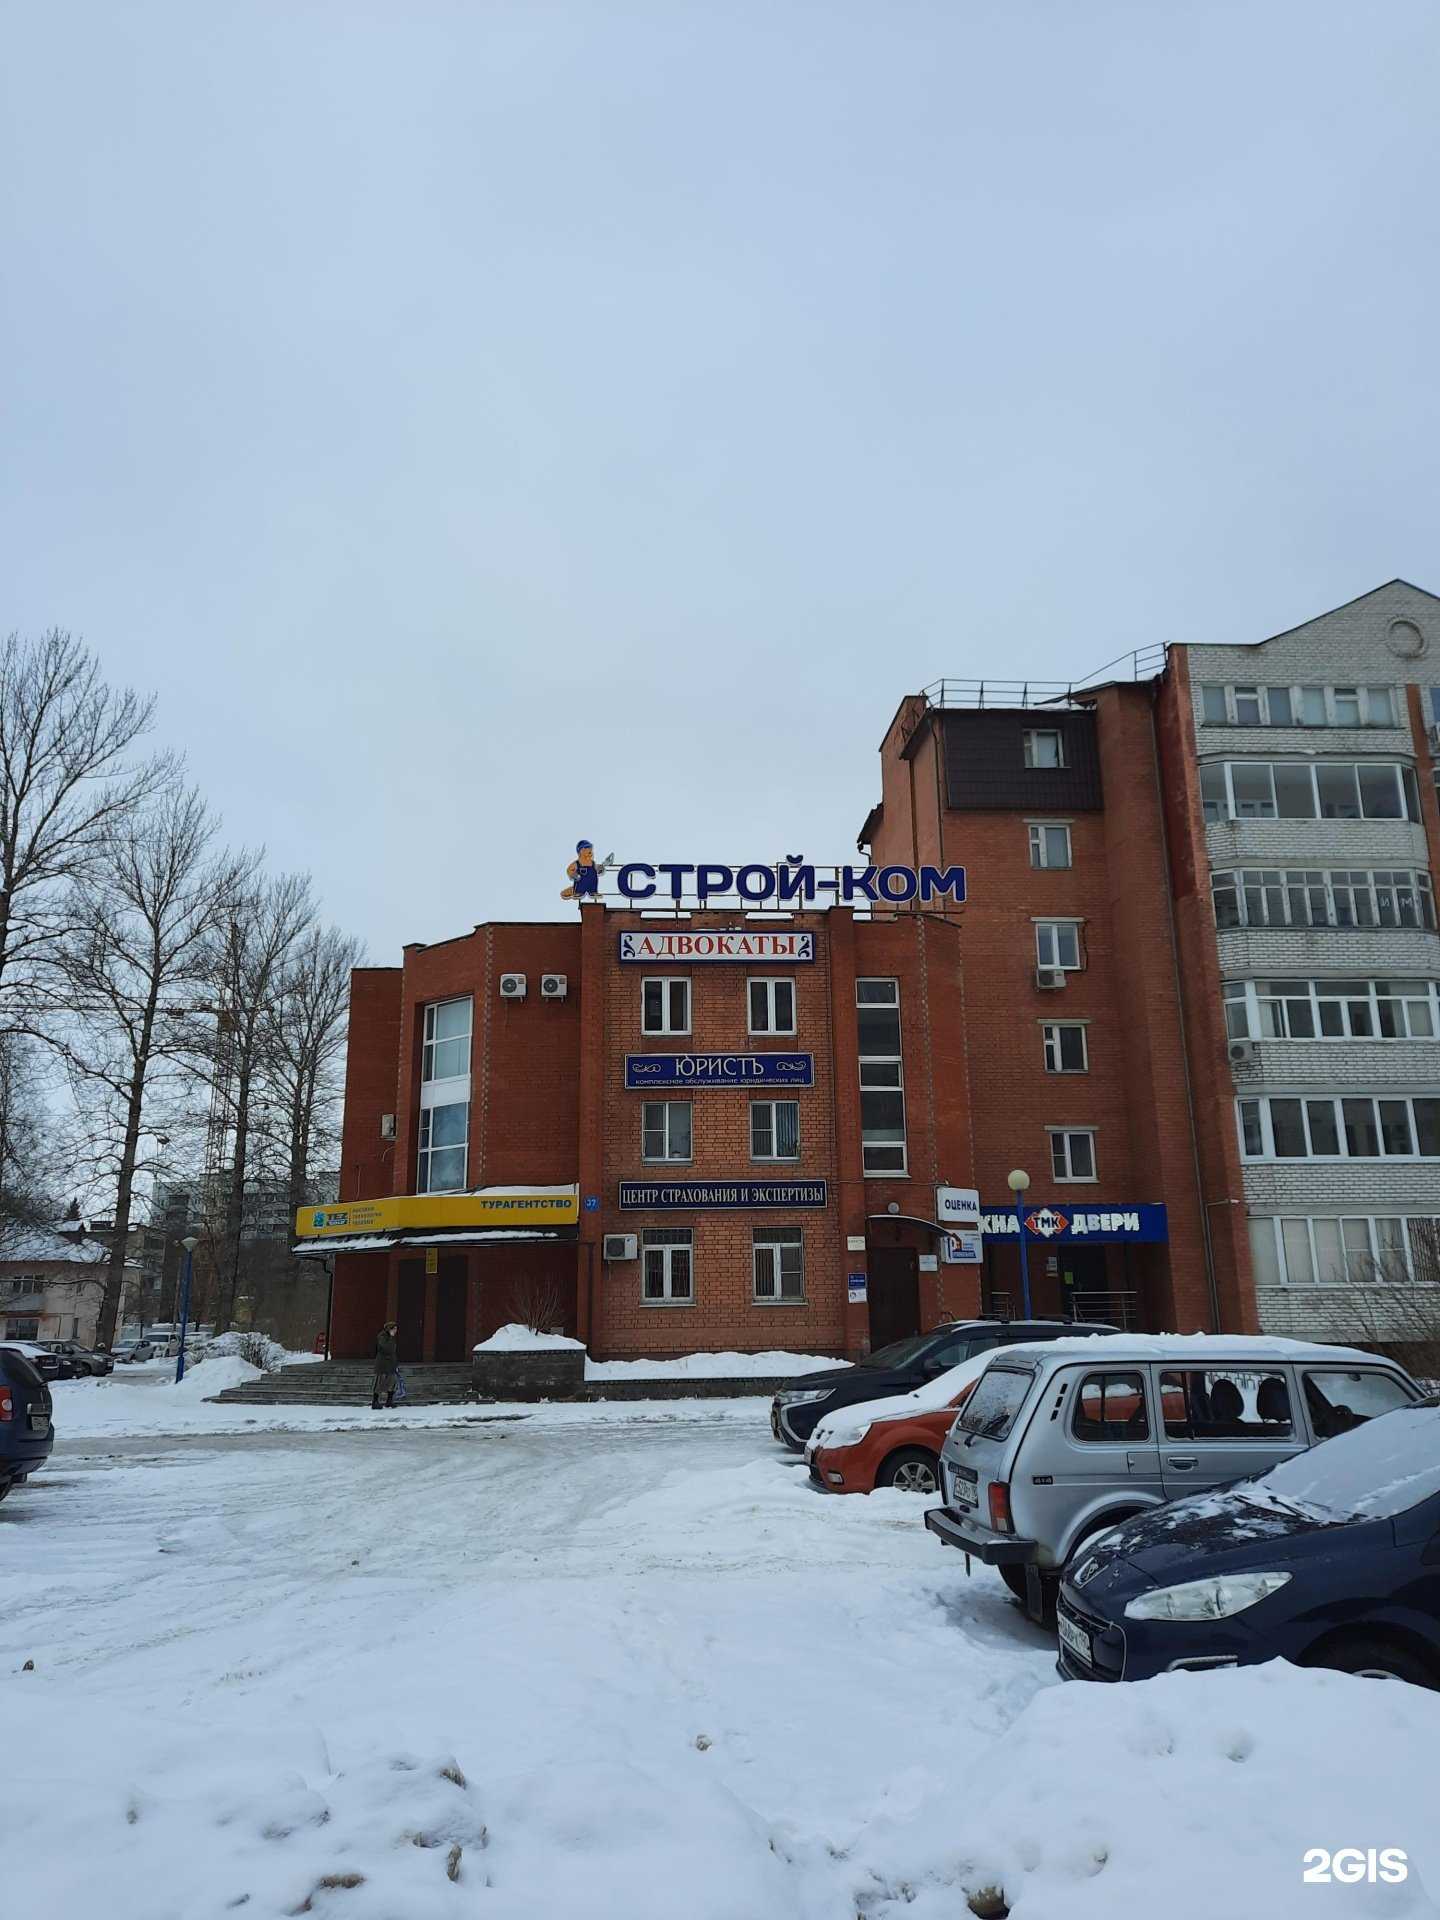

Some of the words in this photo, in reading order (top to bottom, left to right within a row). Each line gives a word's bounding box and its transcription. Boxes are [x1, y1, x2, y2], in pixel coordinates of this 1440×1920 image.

[617, 854, 967, 903] СТРОЙ-КОМ
[638, 935, 797, 958] АДВОКАТЫ
[675, 1055, 764, 1076] ЮРИСТЪ
[480, 1199, 572, 1210] ТУРАГЕНТСТВО
[622, 1189, 658, 1204] ЦЕНТР
[661, 1188, 737, 1203] СТРАХОВАНИЯ
[740, 1188, 749, 1202] И
[752, 1187, 824, 1202] ЭКСПЕРТИЗЫ
[944, 1199, 978, 1211] ОЦЕНКА
[976, 1214, 1021, 1234] КНА
[1033, 1216, 1060, 1229] ТМК
[1071, 1213, 1140, 1235] ДВЕРИ
